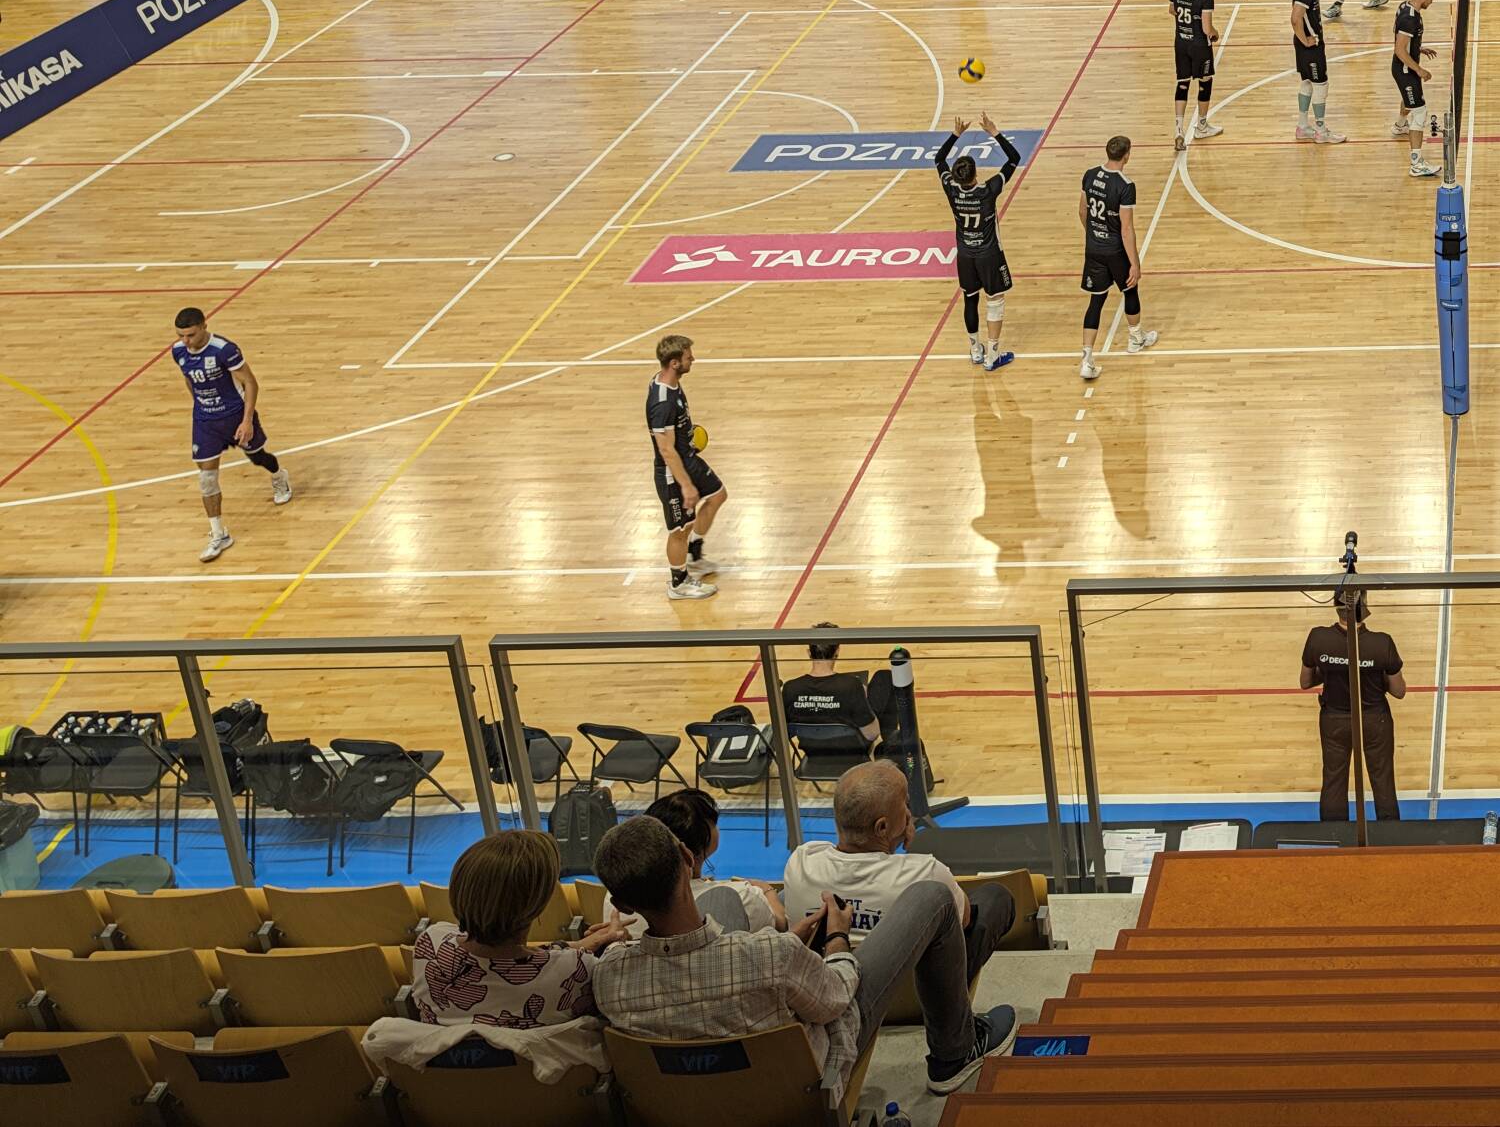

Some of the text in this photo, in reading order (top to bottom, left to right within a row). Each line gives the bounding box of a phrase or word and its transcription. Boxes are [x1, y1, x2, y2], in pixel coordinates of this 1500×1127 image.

[1177, 7, 1192, 24] 25
[1089, 197, 1106, 221] 32
[959, 213, 981, 228] 77
[750, 247, 958, 268] TAURON
[188, 369, 206, 384] 10
[1329, 656, 1375, 668] DECALON
